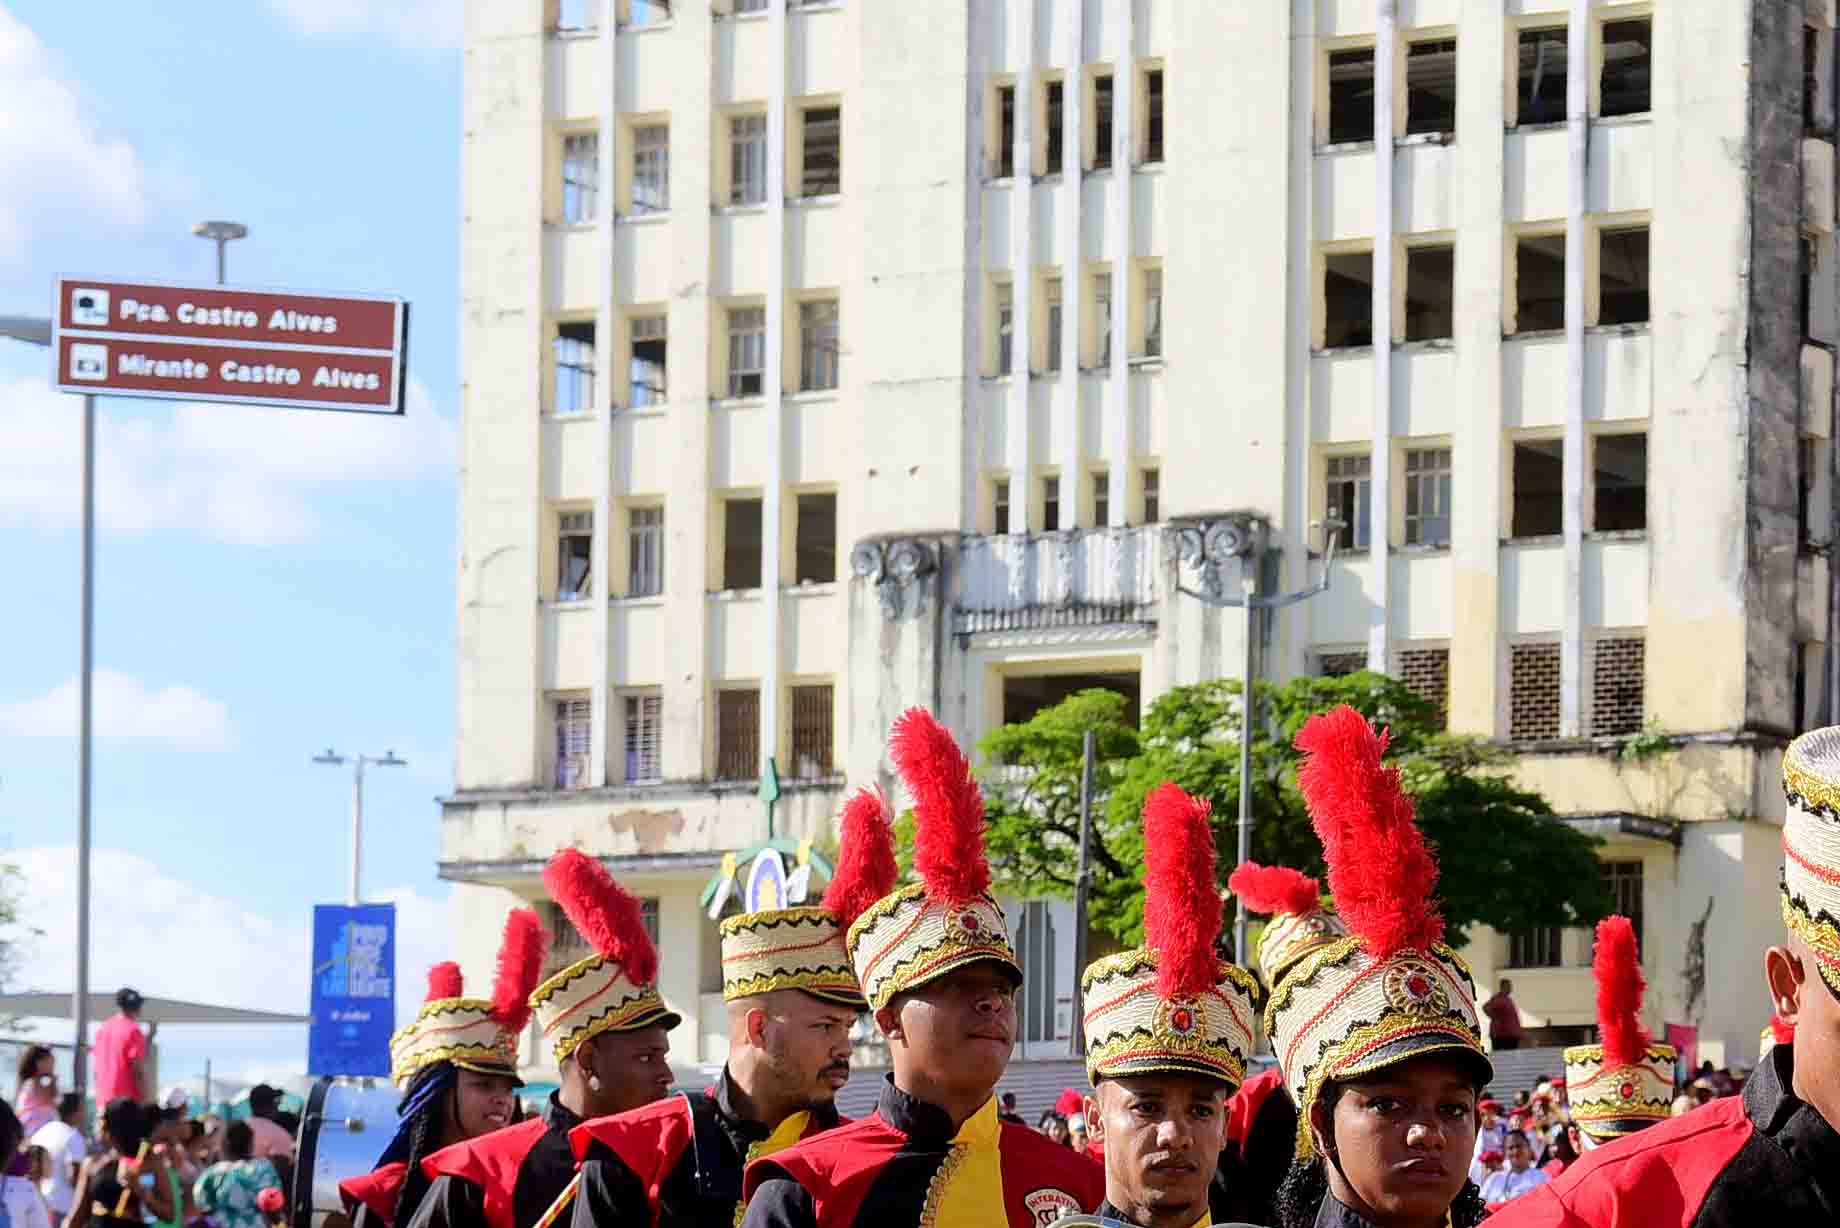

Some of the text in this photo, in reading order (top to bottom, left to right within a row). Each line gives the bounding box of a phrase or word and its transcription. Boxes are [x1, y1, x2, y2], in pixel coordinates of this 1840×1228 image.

[176, 302, 259, 328] Castro
[268, 309, 338, 334] Alves
[117, 352, 380, 390] Mirante Castro Alves
